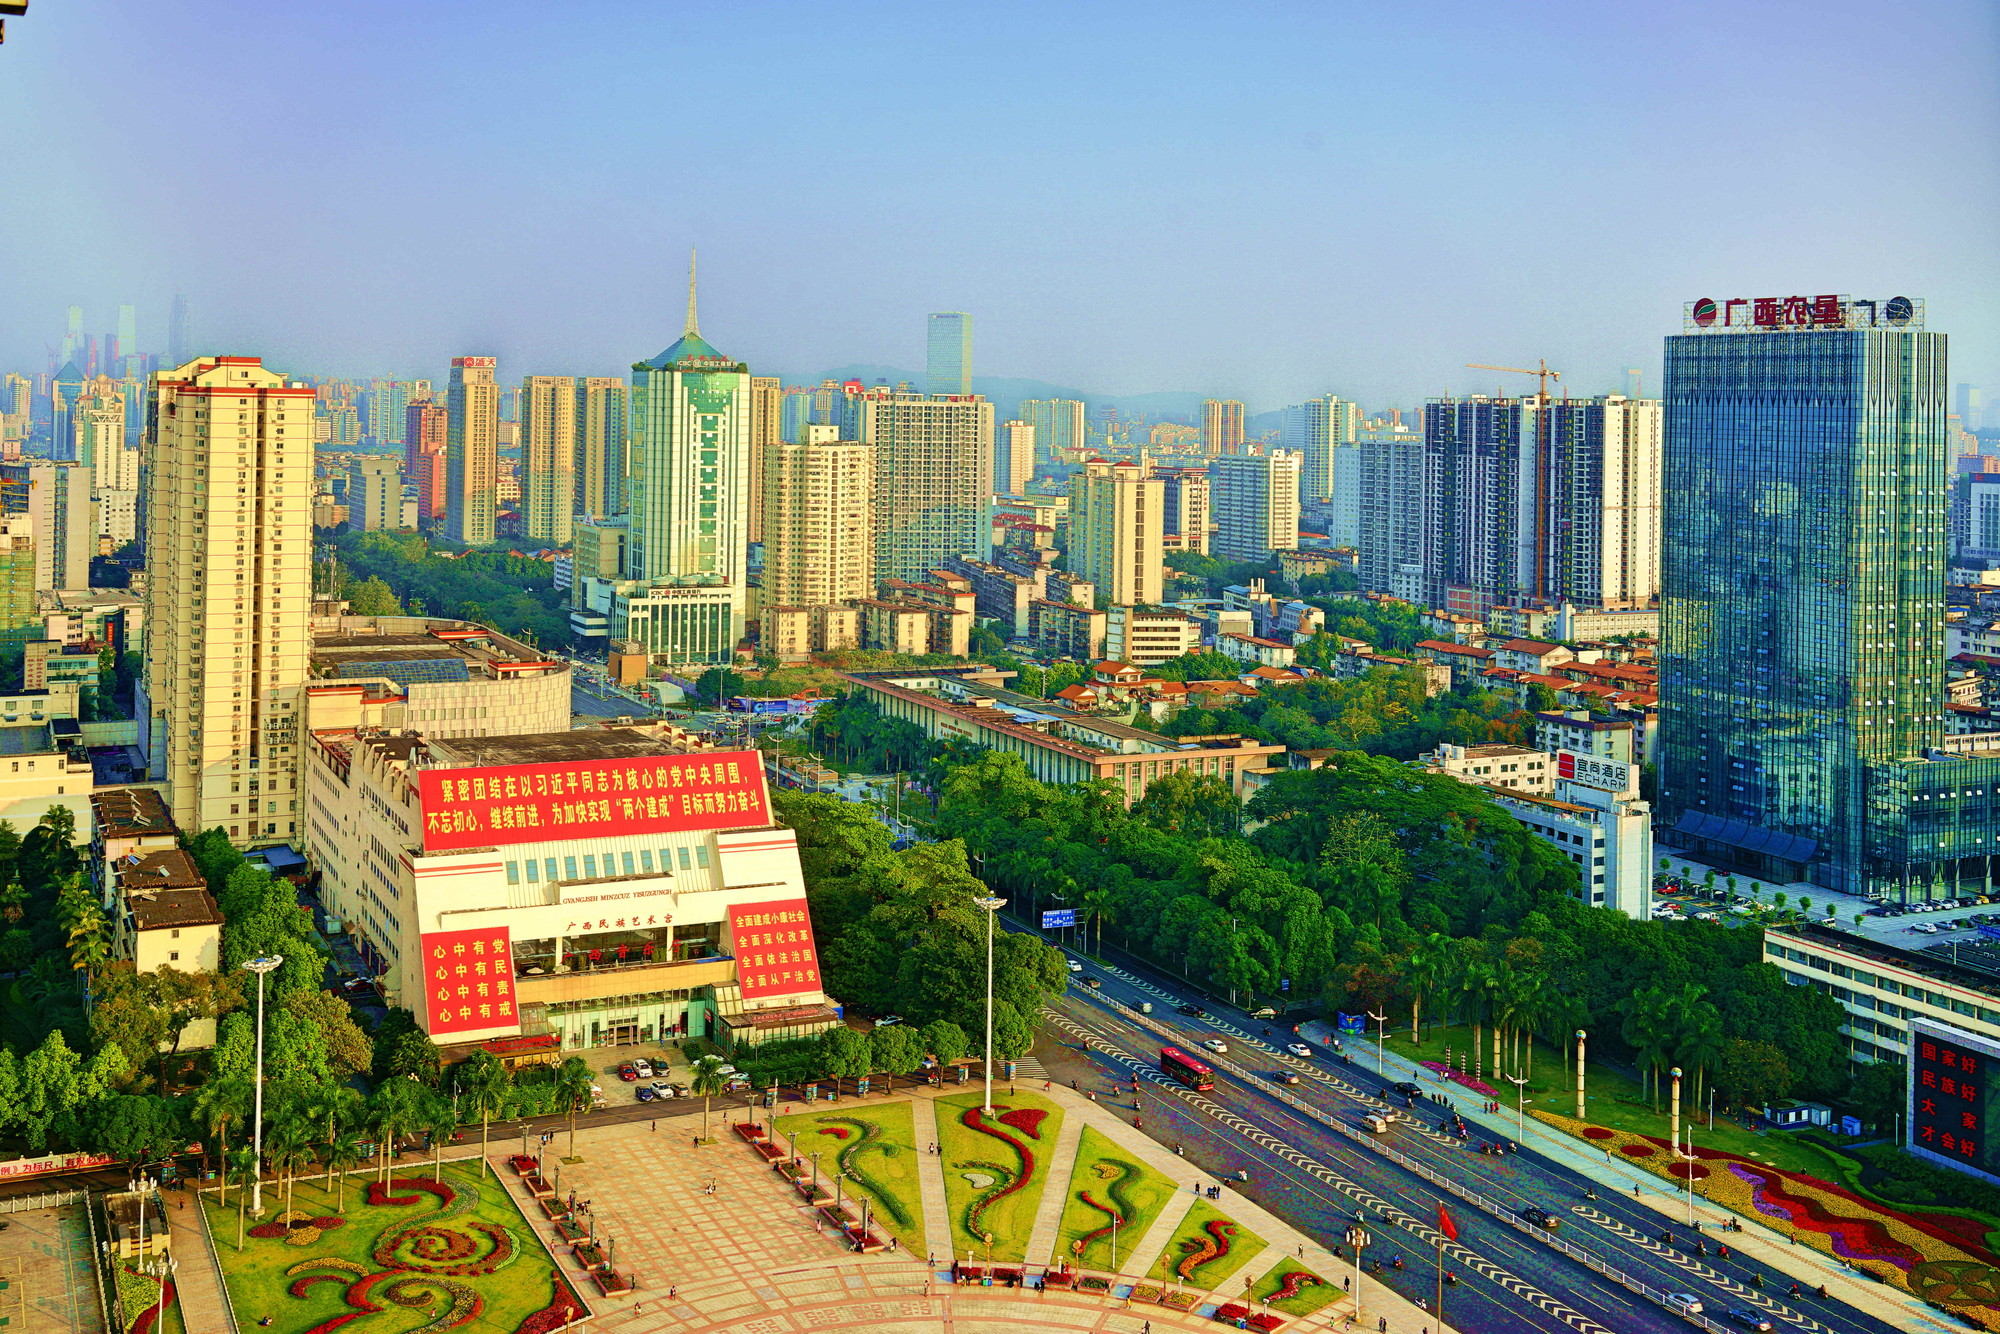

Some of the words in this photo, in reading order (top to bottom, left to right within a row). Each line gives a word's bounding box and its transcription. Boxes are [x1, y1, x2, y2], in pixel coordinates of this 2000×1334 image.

[1724, 295, 1840, 326] 广西农垦
[1576, 758, 1626, 780] 宜尚酒店
[1577, 771, 1626, 790] ECHARM
[600, 893, 631, 901] MINZCUZ
[566, 913, 673, 931] 广西民族艺术宫
[735, 910, 805, 928] 全面建成小康社会
[433, 938, 505, 959] 心中有党
[738, 929, 809, 948] 全面深化改革
[560, 939, 682, 965] 广西音乐厅
[742, 949, 812, 968] 全面依法治国
[435, 959, 507, 980] 心中有民
[745, 969, 816, 988] 全面从严治党
[437, 980, 509, 1001] 心中有责
[439, 1001, 512, 1022] 心中有戒
[1921, 1042, 1976, 1074] 国家好
[1921, 1069, 1976, 1102] 民族好
[1921, 1125, 1976, 1158] 才会好
